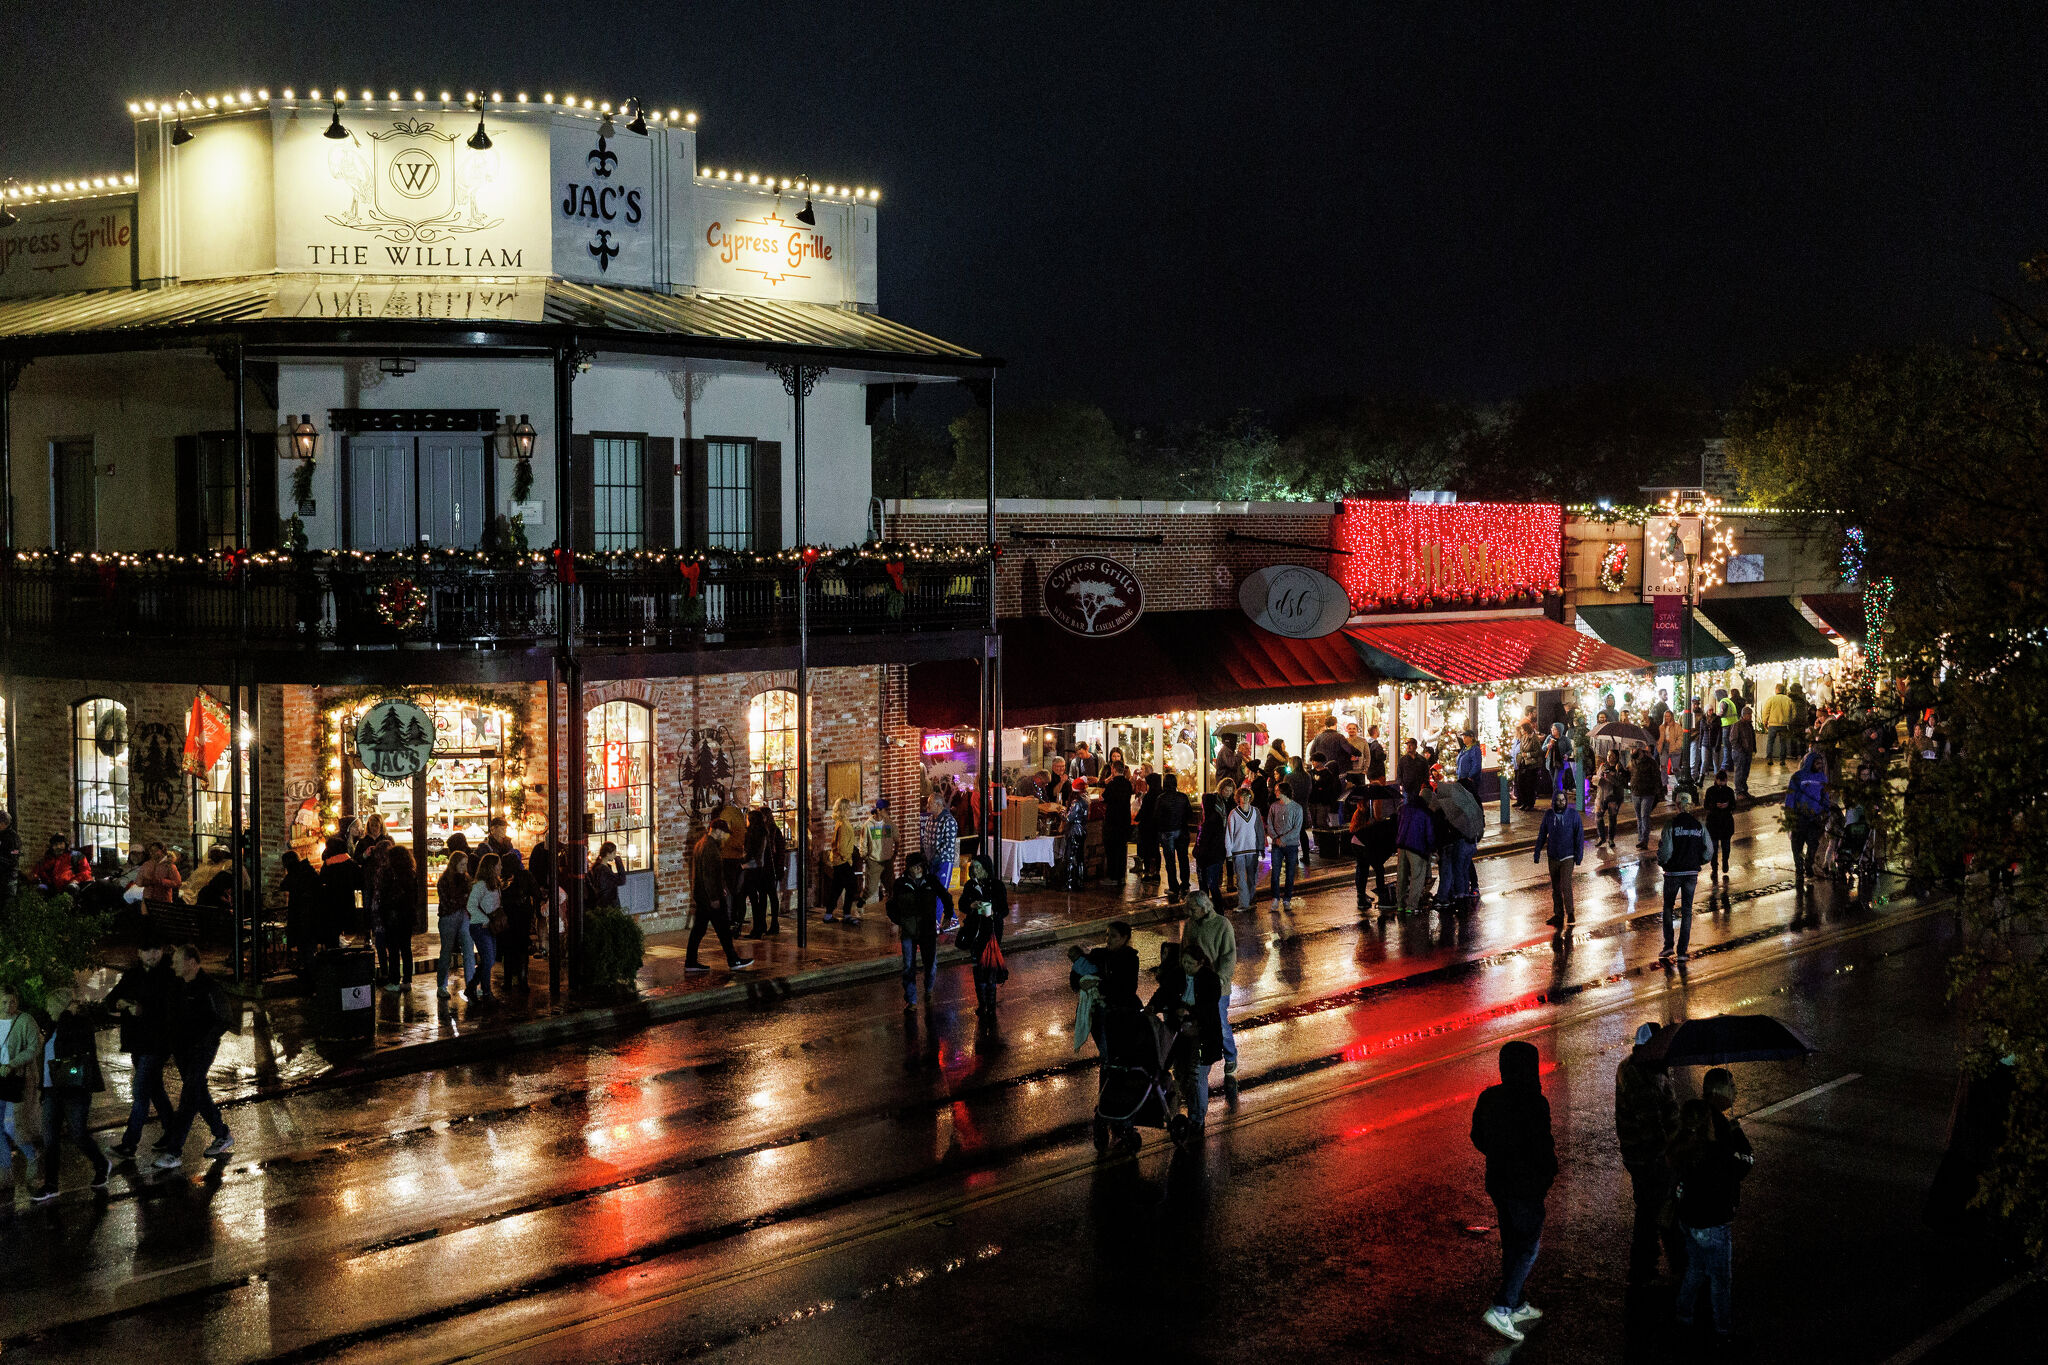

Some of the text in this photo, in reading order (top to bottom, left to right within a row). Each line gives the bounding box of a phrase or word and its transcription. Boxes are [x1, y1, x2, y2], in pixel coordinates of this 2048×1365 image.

[563, 183, 642, 224] JAC'S
[71, 215, 130, 266] Grille
[706, 221, 832, 268] Cypress Grille
[307, 245, 523, 268] THE WILLIAM
[1460, 542, 1519, 588] blue
[1051, 562, 1135, 595] Cypress Grille
[1647, 584, 1690, 593] celest
[1053, 606, 1086, 631] WINE BAR
[1095, 608, 1134, 632] CASUAL DINING
[1655, 622, 1679, 630] LOCAL
[1659, 613, 1676, 621] STAY
[371, 749, 421, 773] JAC'S
[290, 781, 315, 797] 170
[608, 802, 625, 811] FALL
